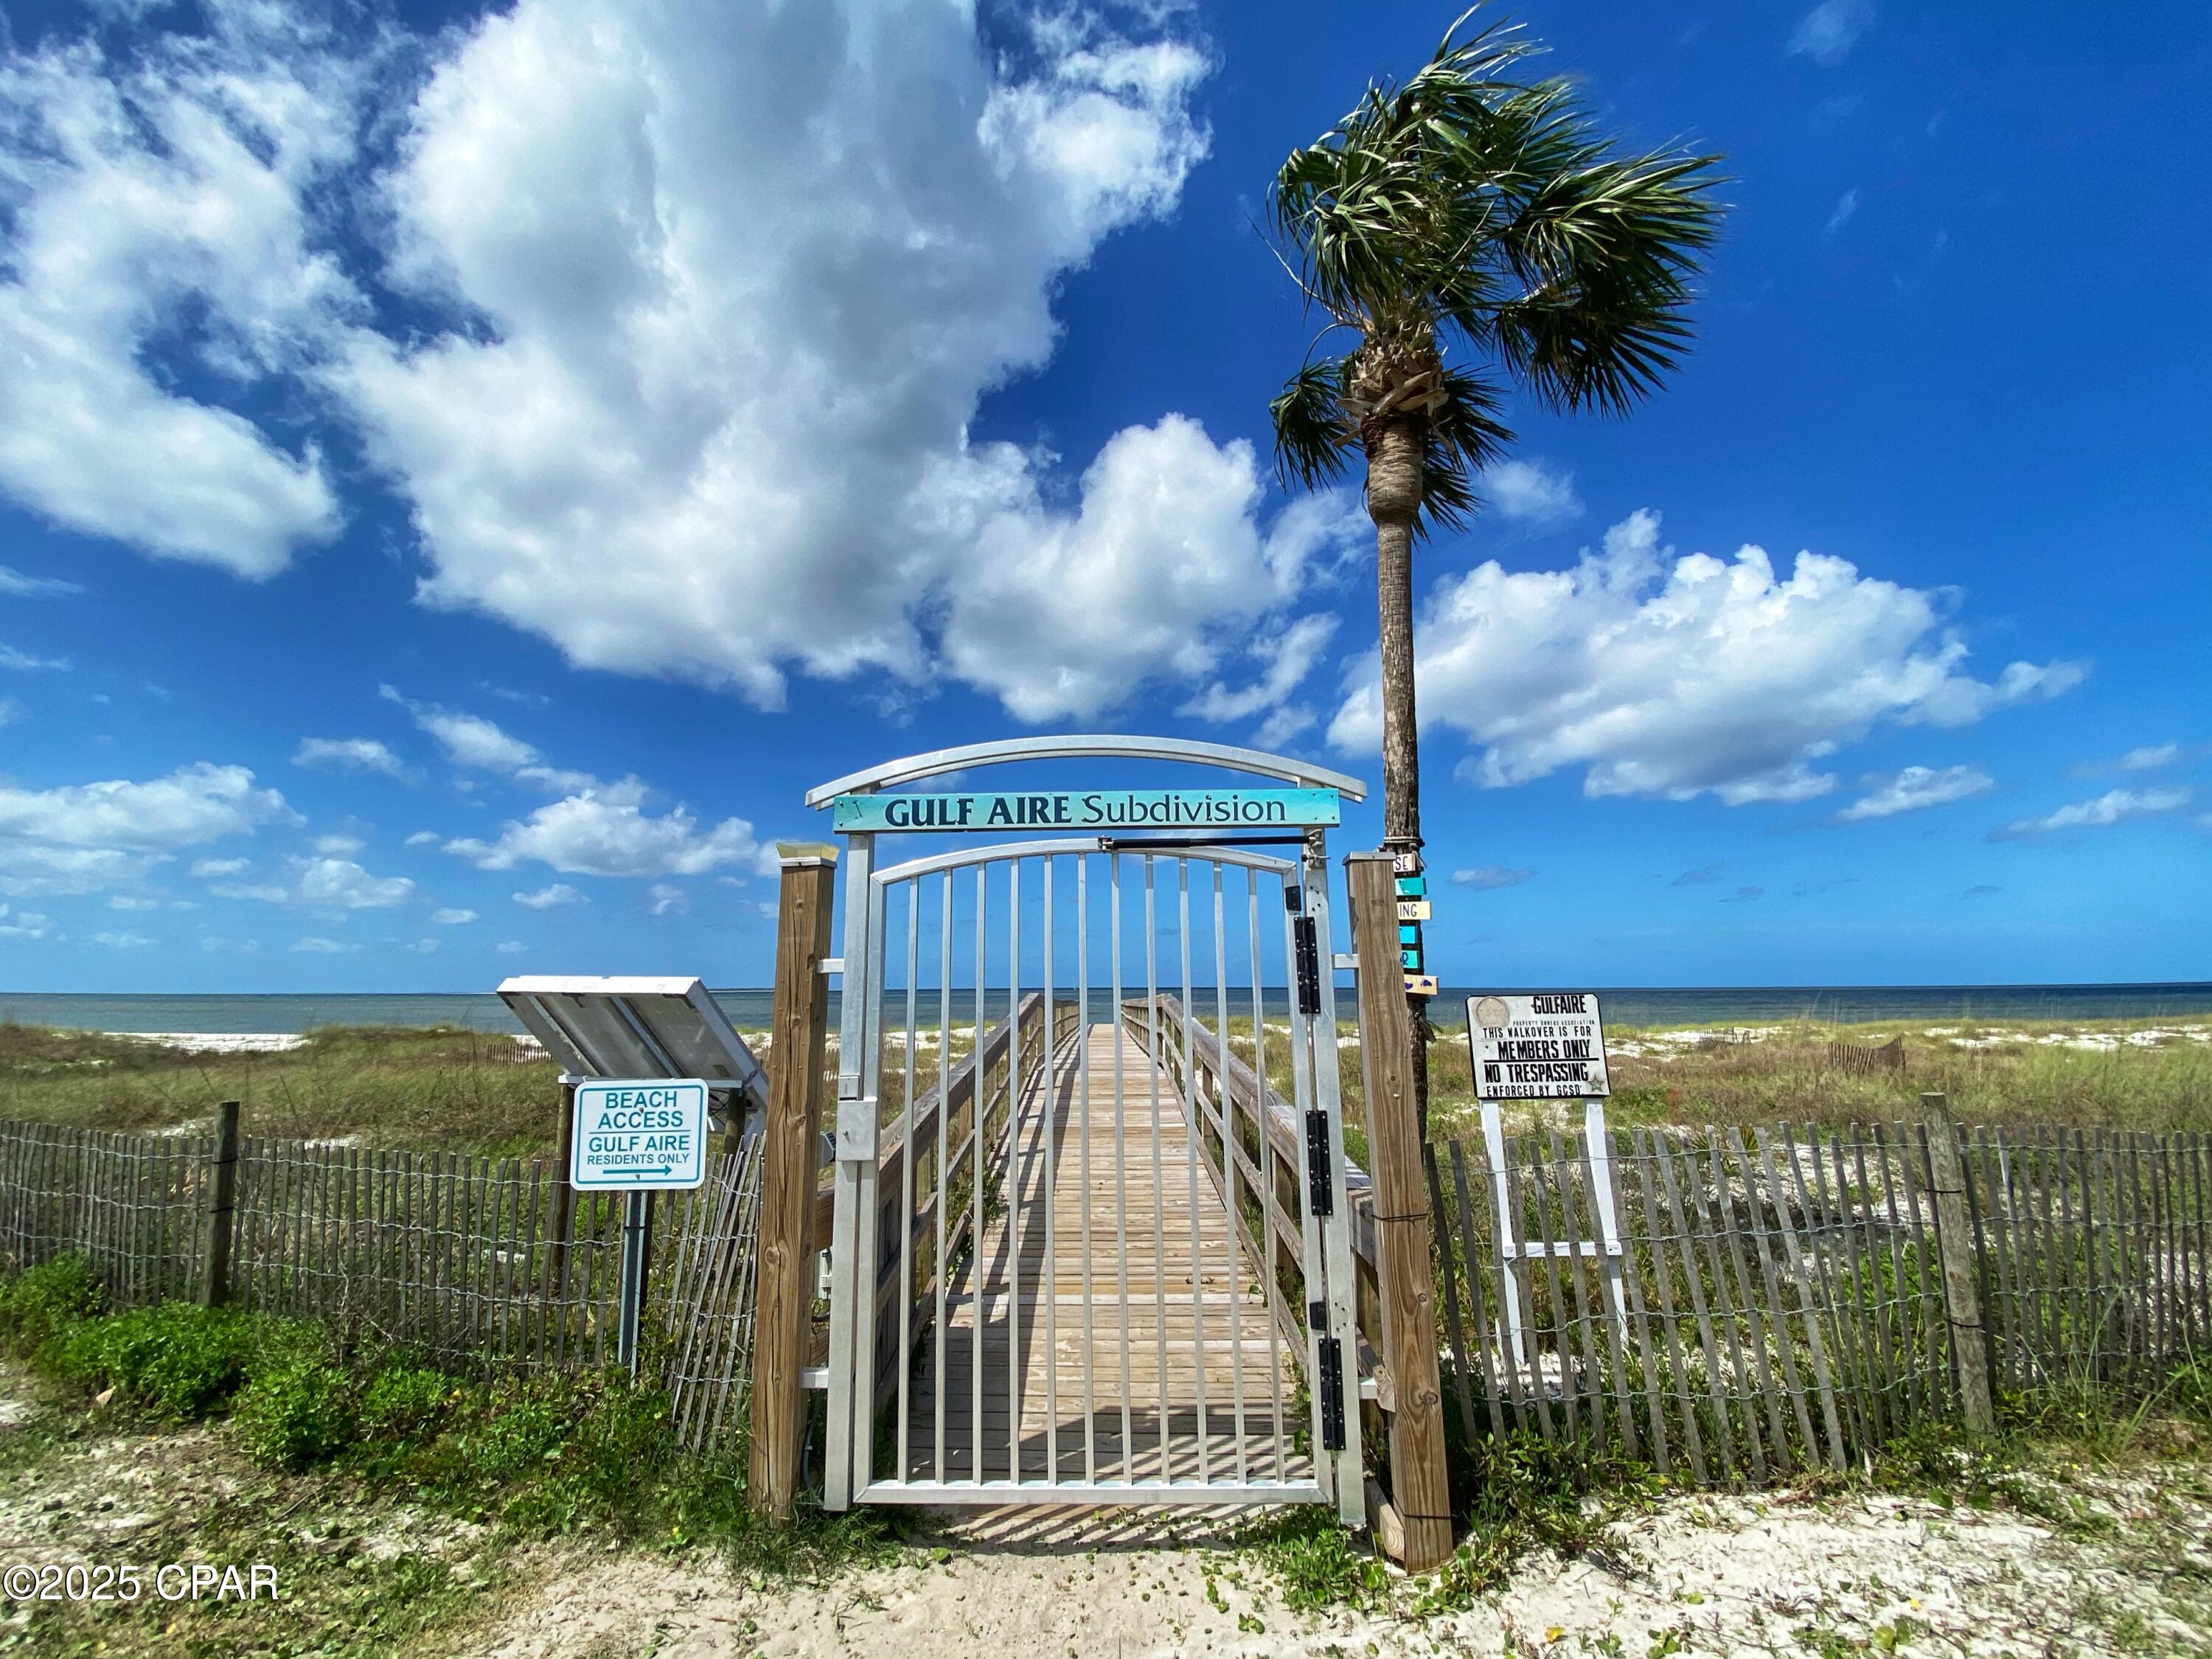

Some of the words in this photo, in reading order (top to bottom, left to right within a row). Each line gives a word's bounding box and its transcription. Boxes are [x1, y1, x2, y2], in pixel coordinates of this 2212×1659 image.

[885, 798, 974, 827] GULF
[987, 796, 1072, 825] AIRE
[1082, 794, 1286, 823] Subdivision
[1533, 995, 1587, 1015] GULFAIRE
[1483, 1027, 1503, 1038] THIS
[1507, 1026, 1554, 1037] WALKOVER
[1559, 1026, 1568, 1037] IS
[1574, 1026, 1592, 1037] FOR
[1498, 1040, 1559, 1060] MEMBERS
[1562, 1039, 1590, 1058] ONLY
[1484, 1064, 1501, 1083] NO
[1506, 1062, 1588, 1082] TRESPASSING
[1539, 1085, 1549, 1095] BY
[605, 1091, 677, 1109] BEACH
[597, 1110, 684, 1129] ACCESS
[589, 1136, 640, 1152] GULF
[644, 1135, 690, 1151] AIRE
[587, 1154, 654, 1165] RESIDENTS
[658, 1153, 689, 1164] ONLY
